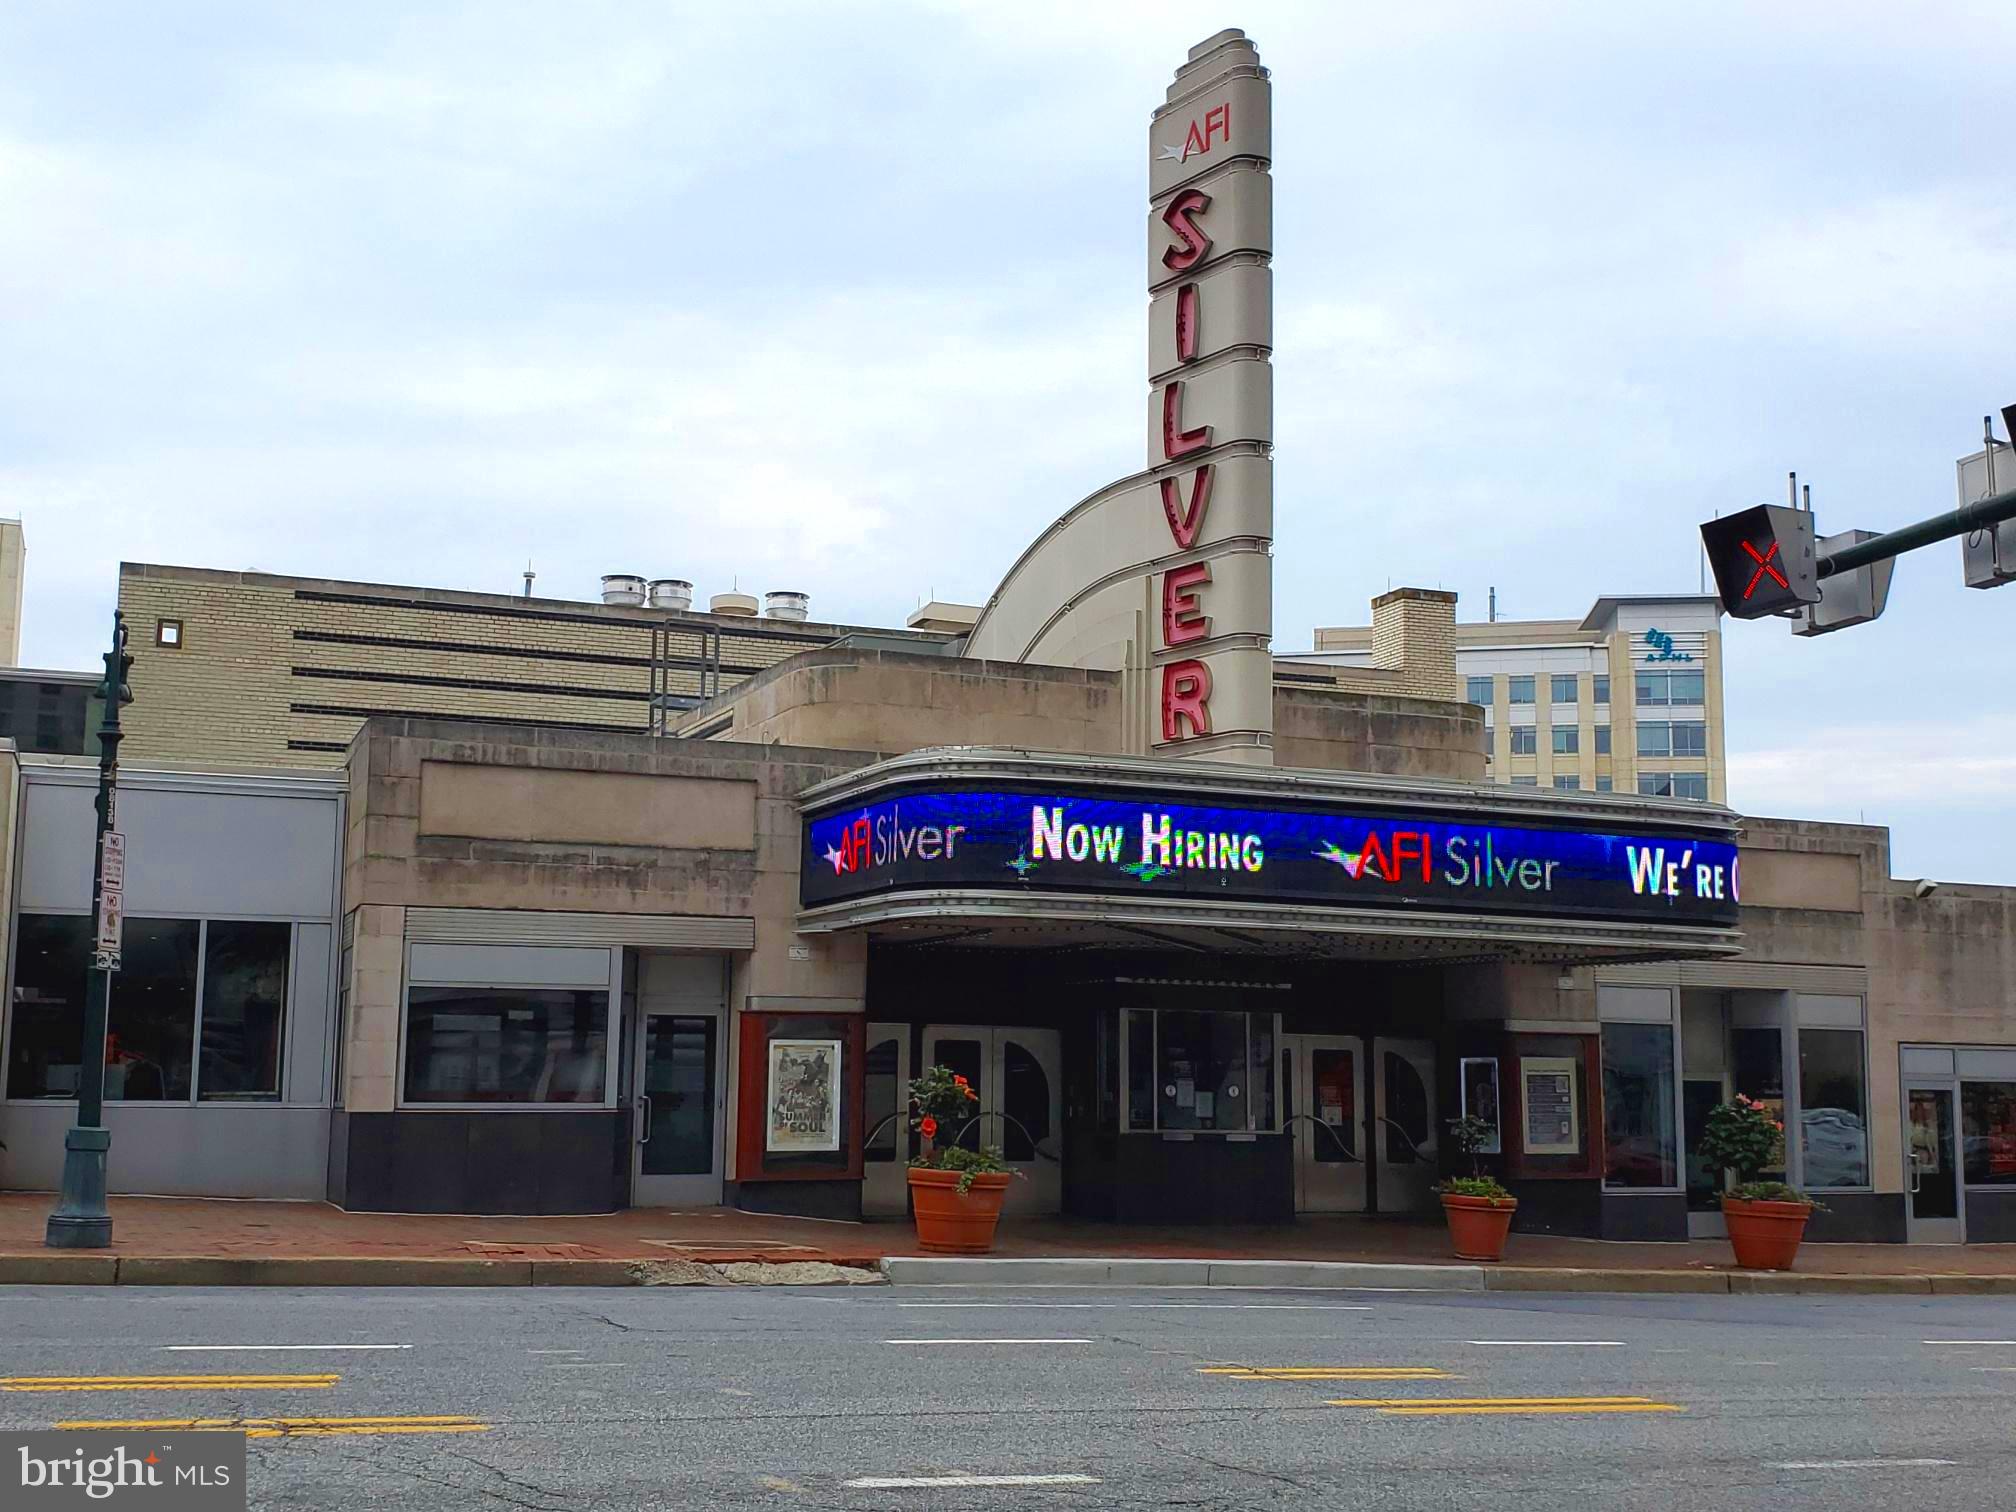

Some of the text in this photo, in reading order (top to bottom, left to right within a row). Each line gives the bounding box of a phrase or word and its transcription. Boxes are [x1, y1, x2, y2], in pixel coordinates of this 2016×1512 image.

[1183, 103, 1230, 163] AFI
[1160, 188, 1216, 741] SILVER
[110, 836, 119, 847] NO
[836, 804, 965, 877] AFI Silver
[1355, 831, 1560, 891] AFI Silver
[106, 895, 117, 907] NO
[789, 1122, 826, 1133] SOUL
